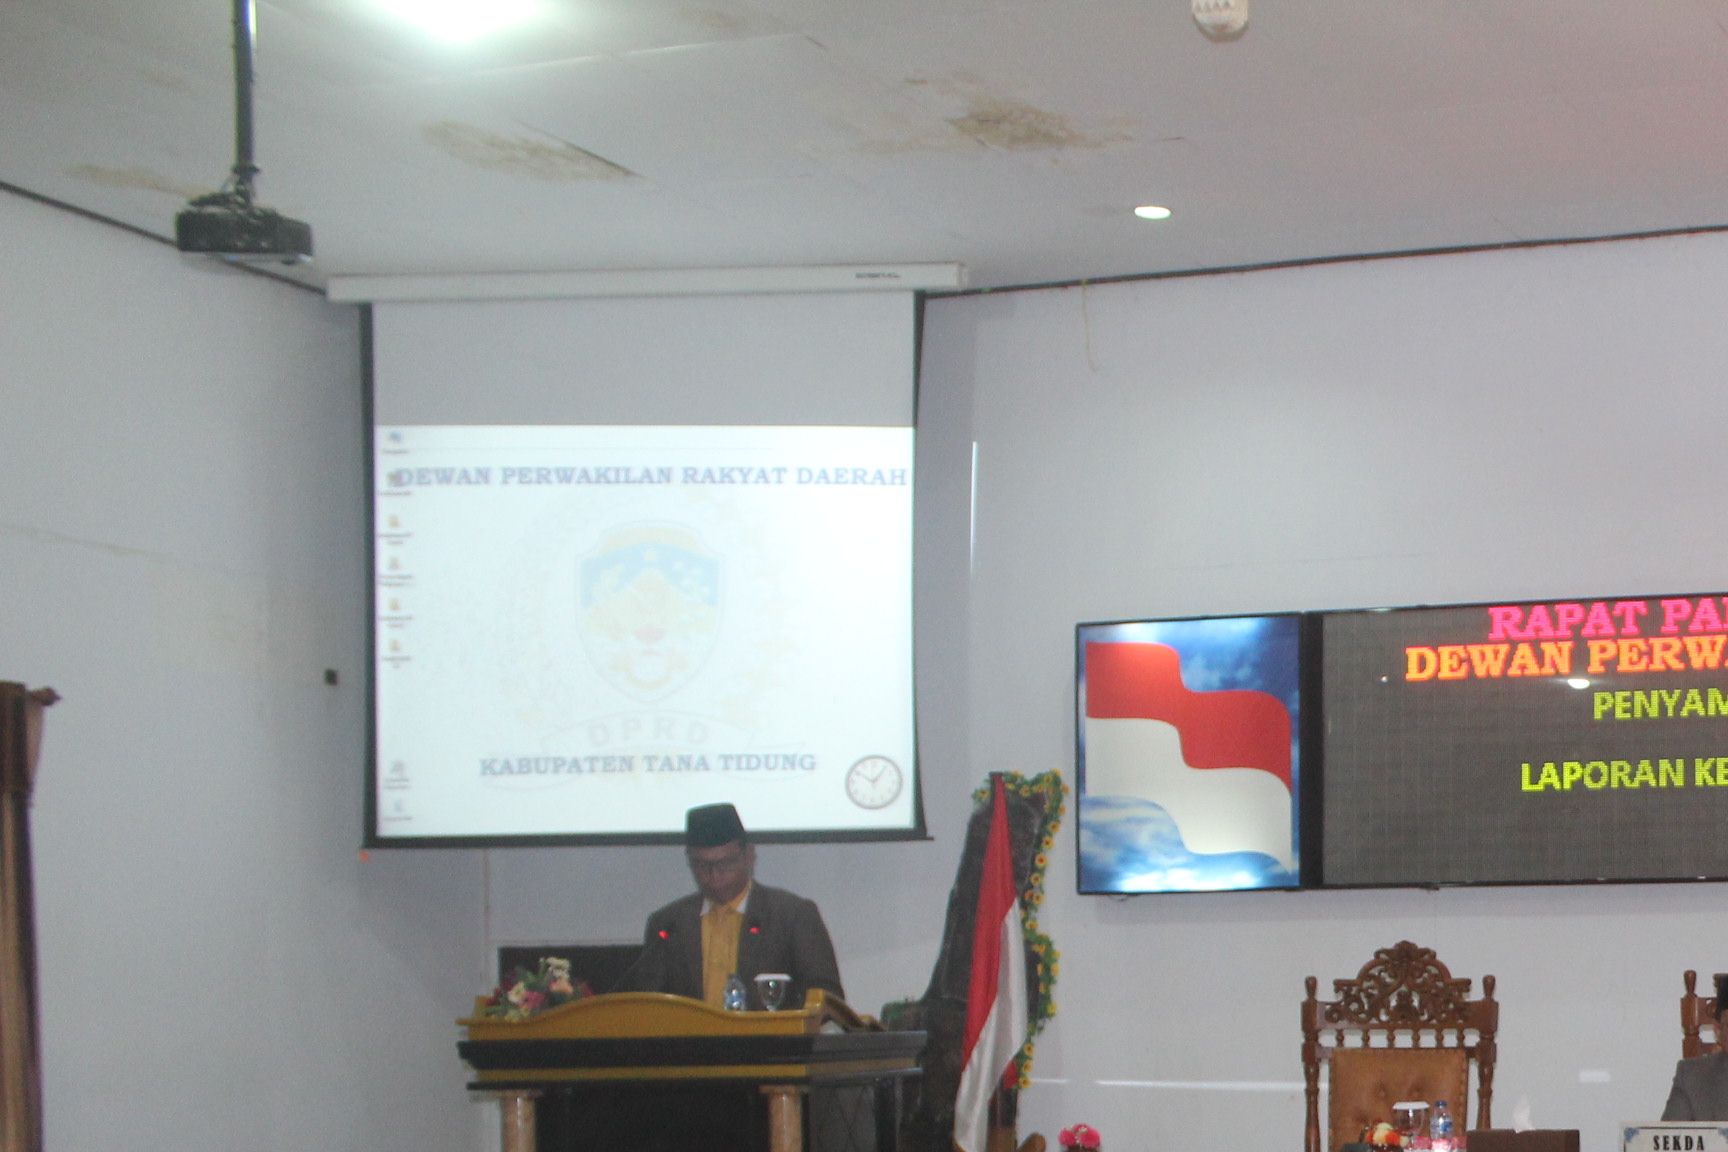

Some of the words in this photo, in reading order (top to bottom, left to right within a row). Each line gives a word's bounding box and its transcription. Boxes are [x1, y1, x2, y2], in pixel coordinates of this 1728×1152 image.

[398, 466, 491, 486] DEWAN
[500, 466, 672, 486] PERWAKILAN
[681, 466, 788, 485] RAKYAT
[795, 467, 908, 486] DAERAH
[1487, 600, 1648, 641] RAPAT
[1405, 641, 1575, 682] DEWAN
[478, 755, 635, 776] KABUPATEN
[641, 755, 711, 773] TANA
[717, 753, 817, 772] TIDUNG
[1521, 758, 1684, 792] LAPORAN
[1653, 1135, 1705, 1151] SEKDA
